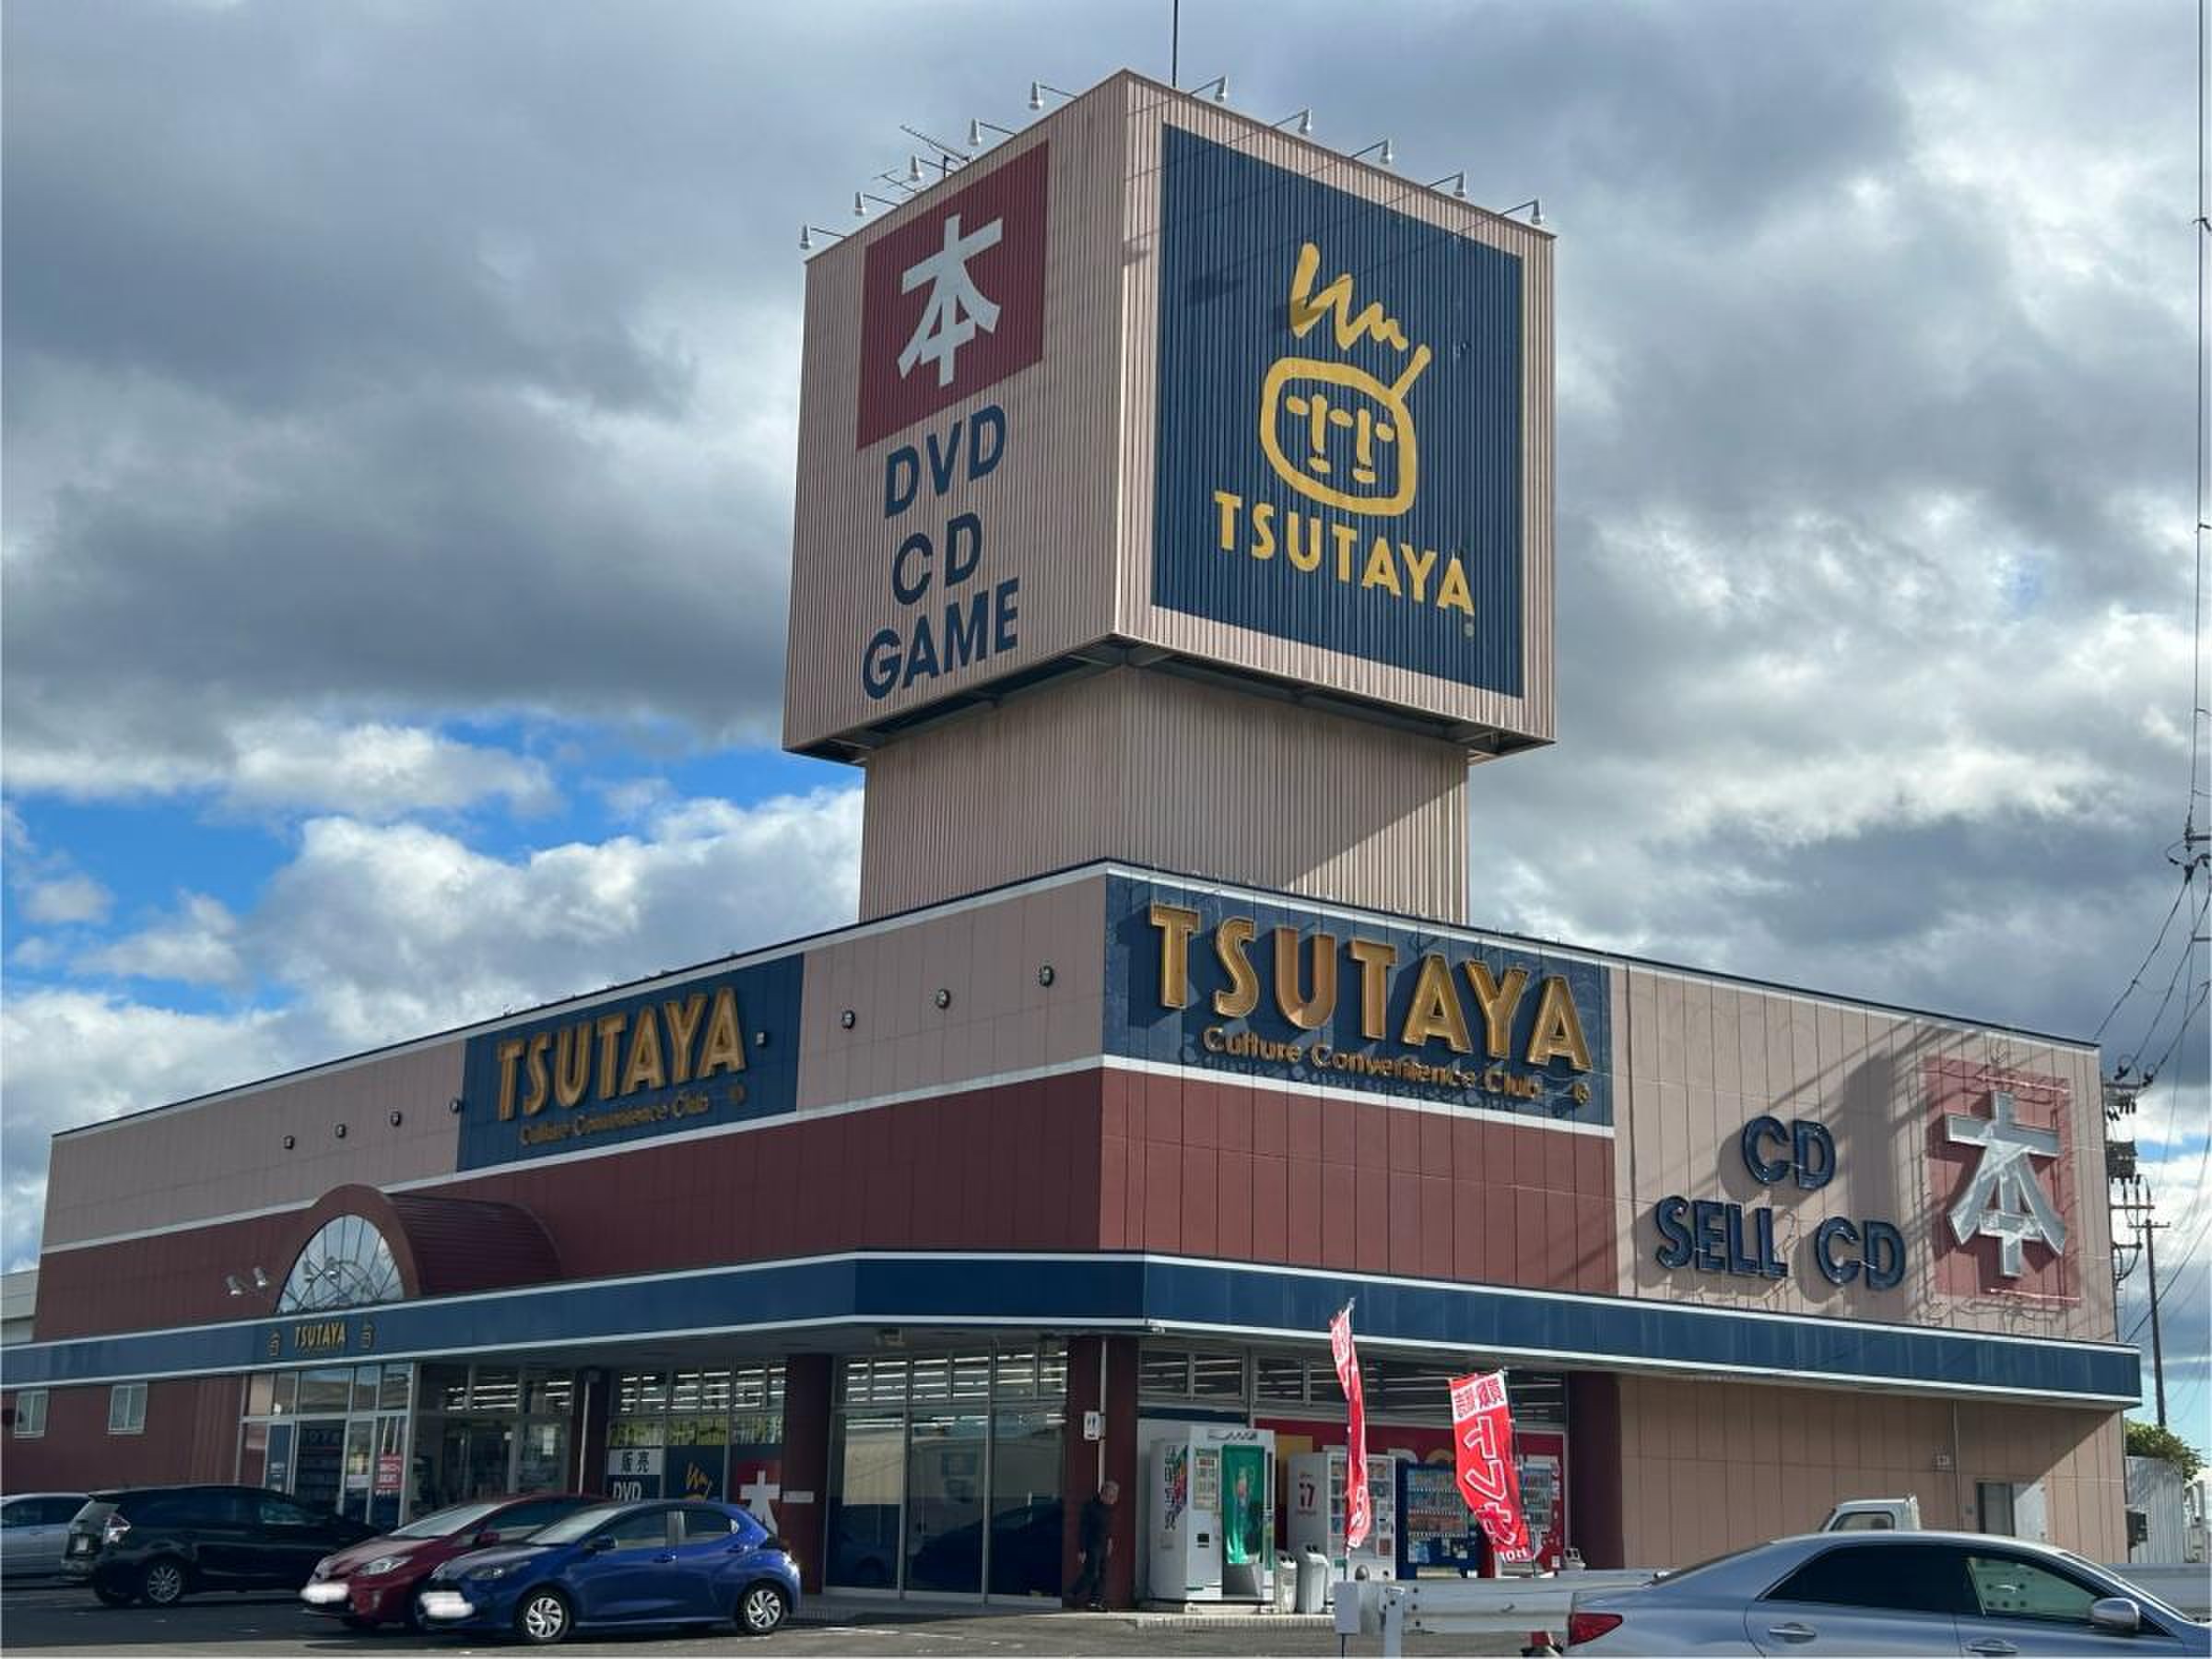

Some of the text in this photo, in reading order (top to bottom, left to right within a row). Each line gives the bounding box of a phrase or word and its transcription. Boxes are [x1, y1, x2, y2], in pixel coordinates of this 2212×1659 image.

[897, 213, 1003, 387] 本
[885, 406, 1006, 519] DVD
[892, 512, 982, 606] CD
[1214, 490, 1475, 616] TSUTAYA
[863, 577, 1018, 700] GAME
[1150, 902, 1593, 1072] TSUTAYA
[498, 986, 746, 1122] TSUTAYA
[1203, 1026, 1544, 1100] Culture Convenience Club
[1742, 1115, 1837, 1191] CD
[1947, 1090, 2065, 1277] 本
[1655, 1194, 1907, 1291] SELL CD
[295, 1321, 347, 1348] TSUTAYA
[612, 1480, 642, 1502] DVD
[620, 1450, 650, 1474] 販売
